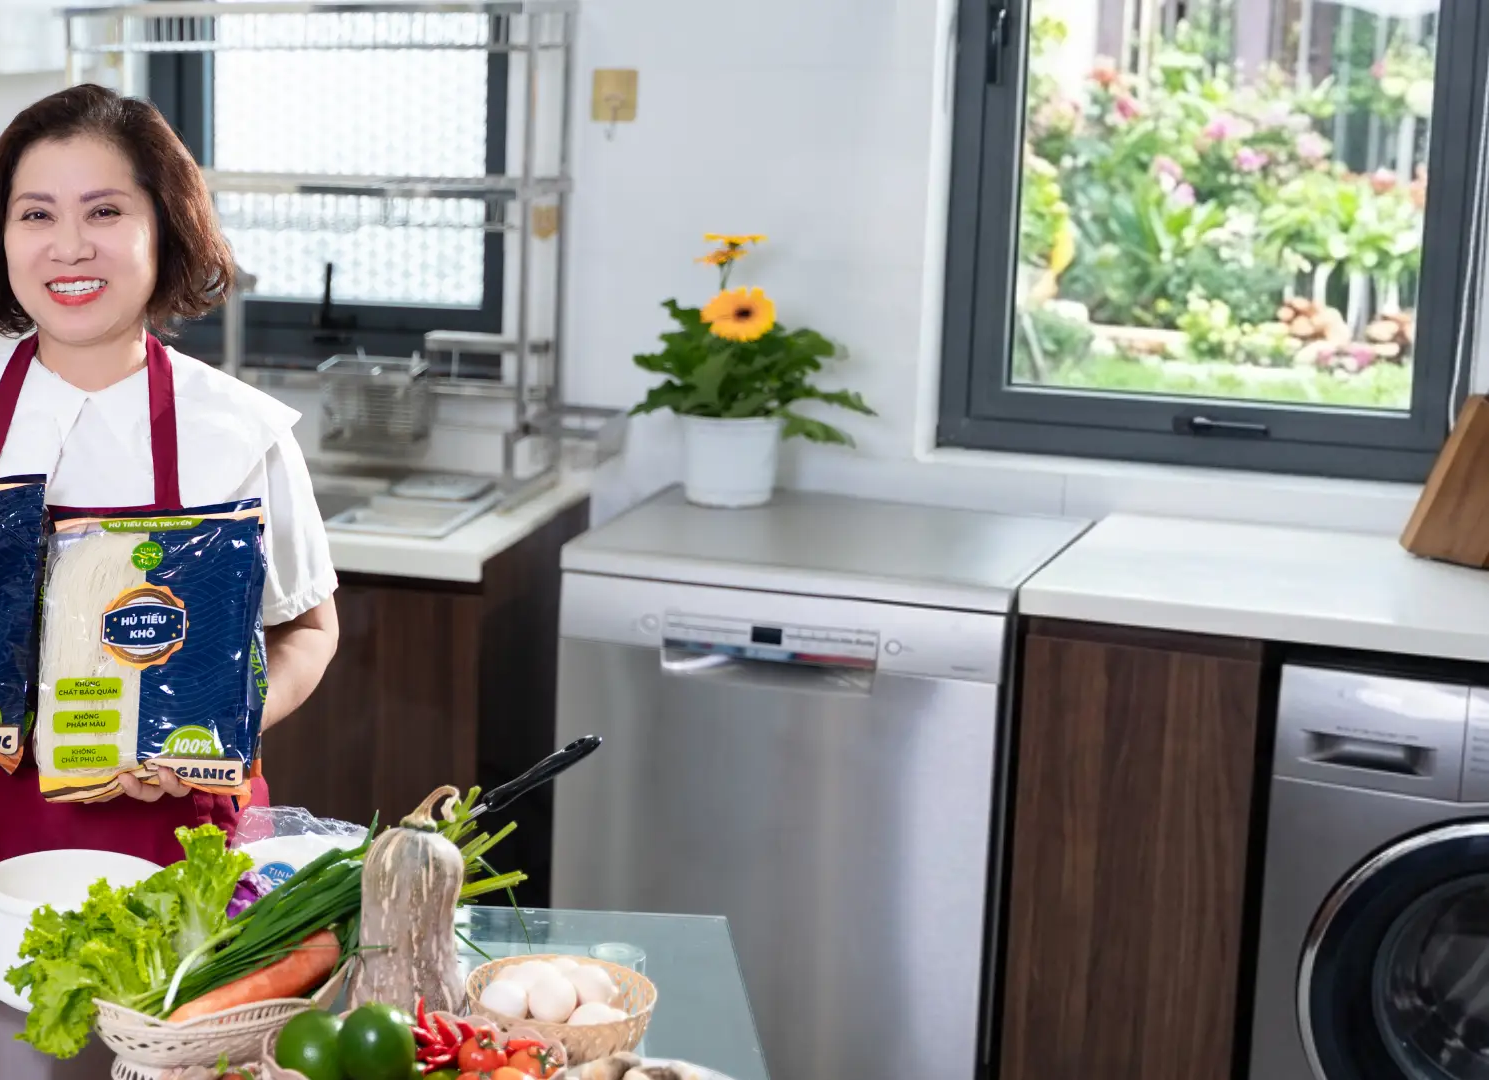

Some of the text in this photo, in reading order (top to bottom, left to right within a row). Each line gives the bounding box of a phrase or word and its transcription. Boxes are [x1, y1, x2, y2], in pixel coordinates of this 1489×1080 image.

[121, 612, 167, 626] HỦ TIẾU
[130, 627, 156, 639] KHÔ
[173, 738, 212, 754] 100%
[175, 766, 236, 781] GANIC
